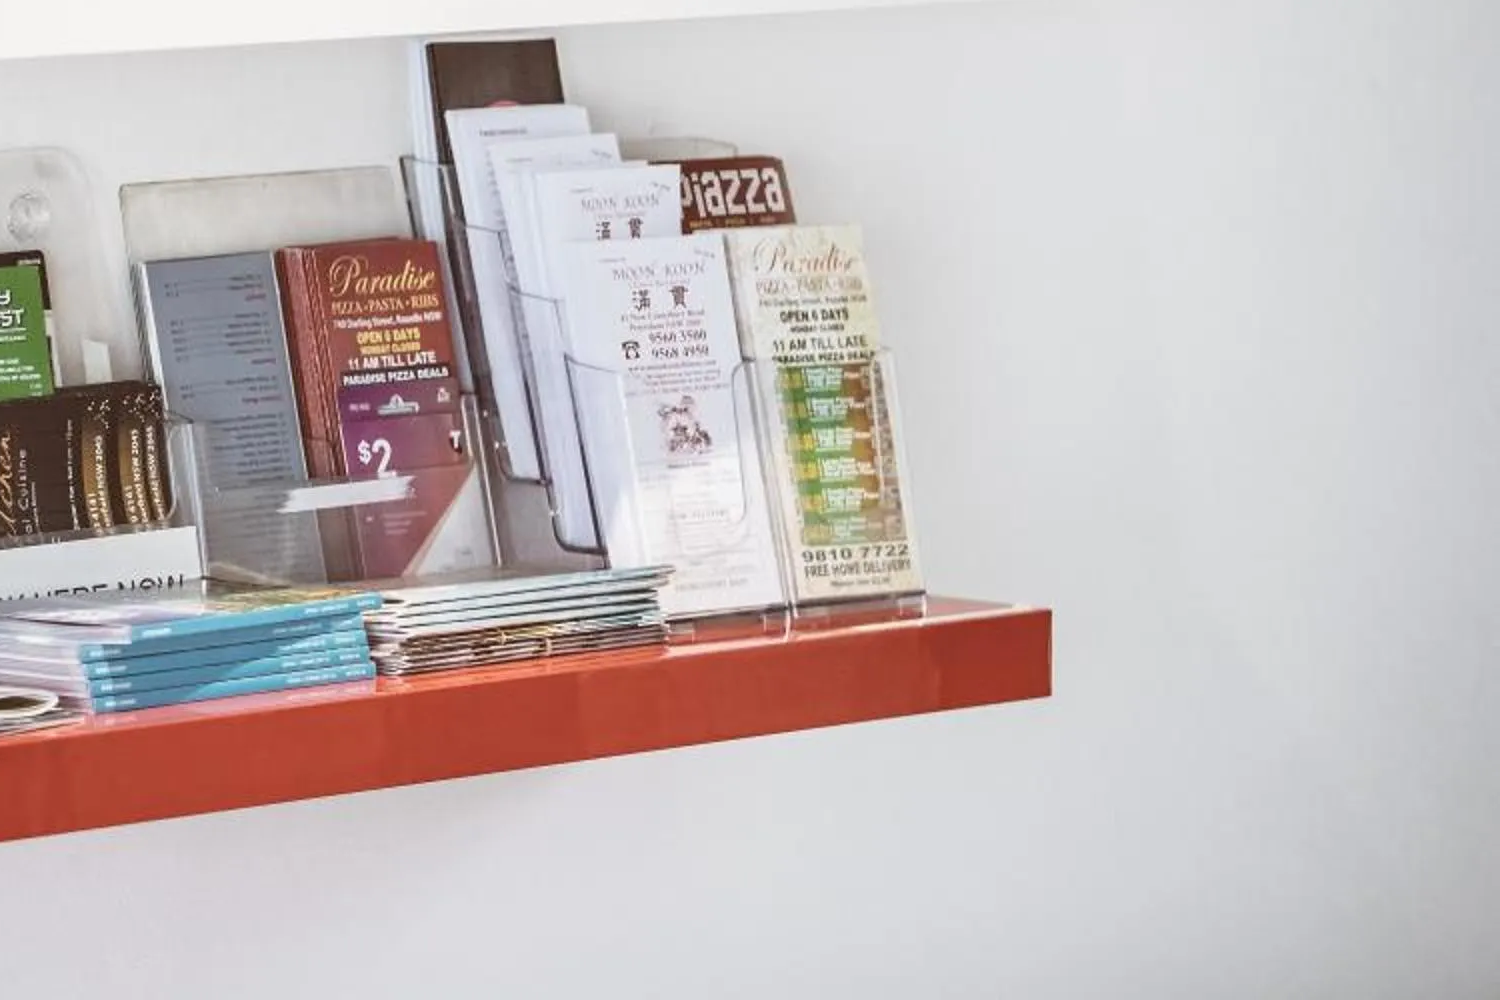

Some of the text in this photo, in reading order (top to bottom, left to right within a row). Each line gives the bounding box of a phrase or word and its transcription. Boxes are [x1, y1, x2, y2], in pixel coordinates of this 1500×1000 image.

[329, 255, 435, 297] Paradise
[331, 294, 440, 315] PIZZA PASTA RIBS
[780, 309, 810, 323] OPEN
[821, 307, 849, 321] DAYS
[356, 330, 382, 345] OPEN
[393, 327, 420, 342] DAYS
[773, 335, 868, 352] 11 AM TILL LATE
[348, 351, 437, 370] 11 AM TILL LATE
[772, 354, 815, 365] PARADISE
[818, 352, 845, 363] PIZZA
[343, 367, 449, 387] PARADISE PIZZA DEALS
[16, 449, 29, 512] Cuisine
[802, 543, 909, 563] 9810 7722
[804, 563, 830, 579] FREE
